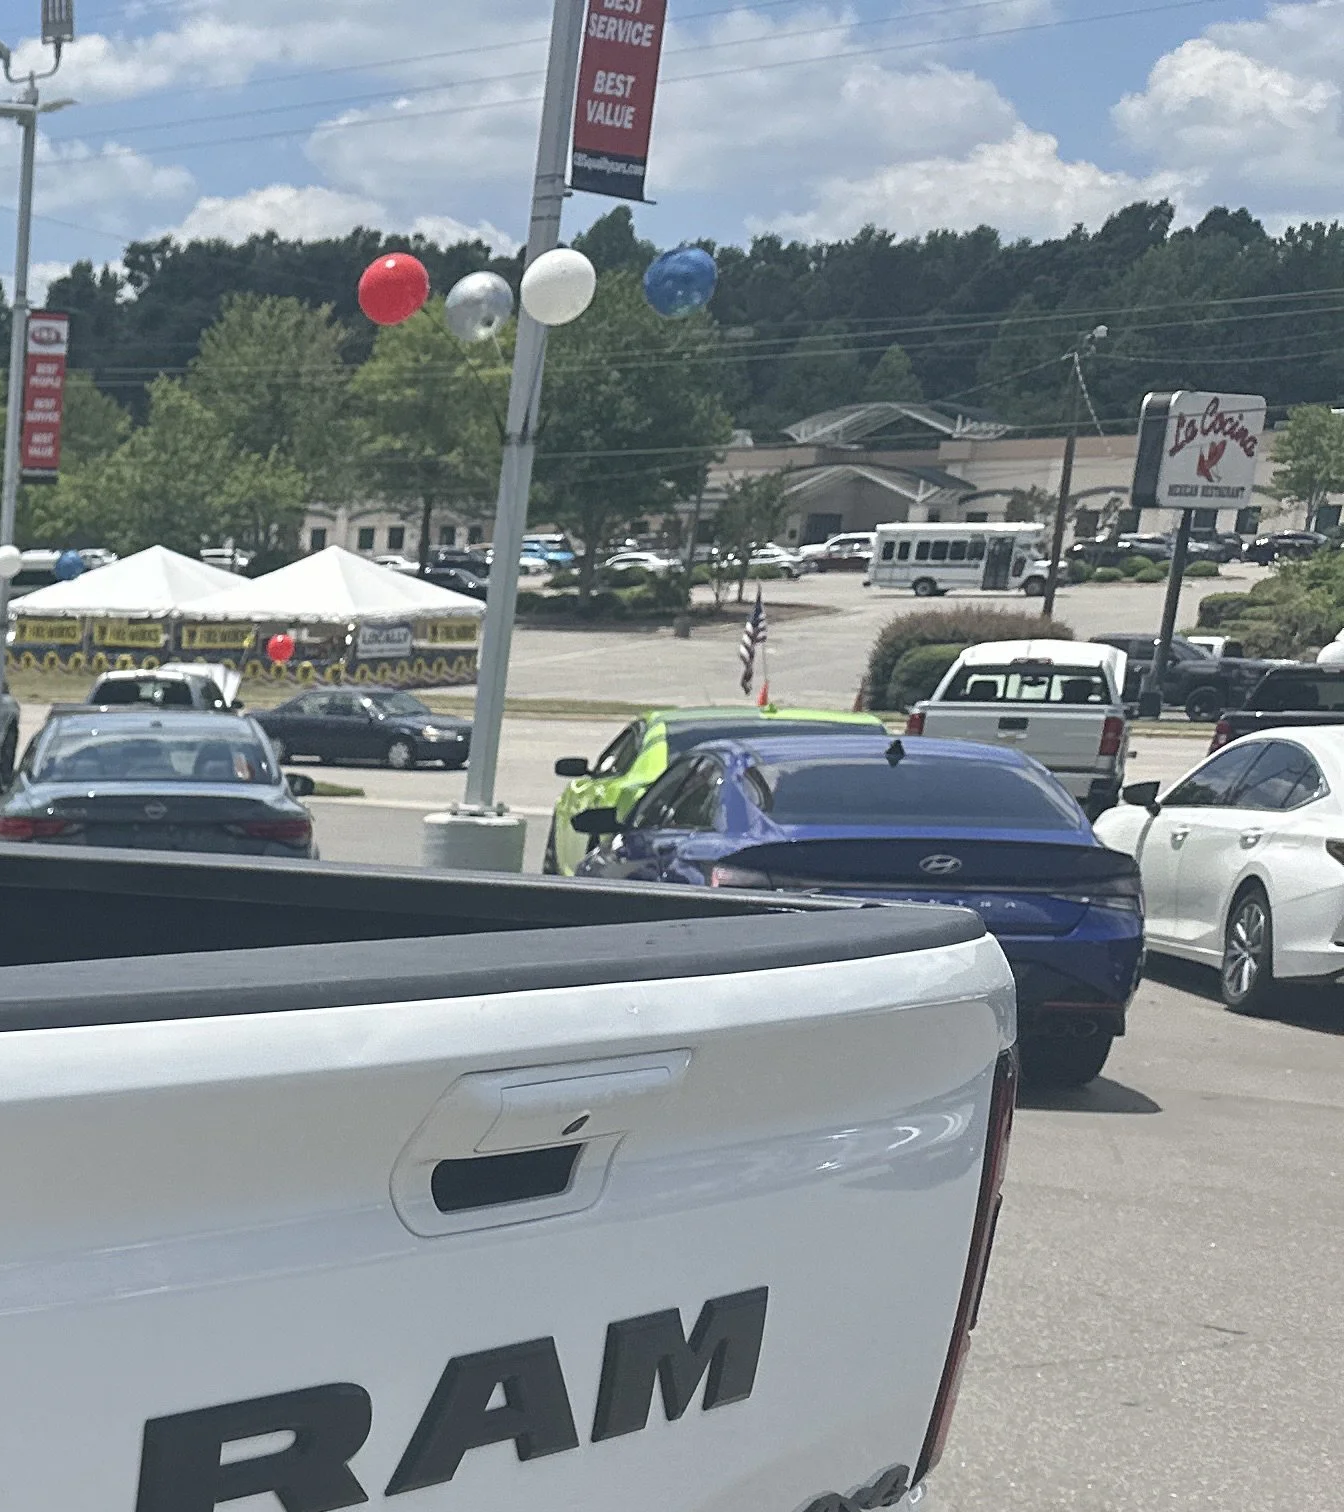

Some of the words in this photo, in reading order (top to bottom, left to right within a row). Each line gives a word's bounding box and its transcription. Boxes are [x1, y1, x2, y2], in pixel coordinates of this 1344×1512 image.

[588, 13, 655, 47] SERVICE
[593, 70, 636, 98] BEST
[587, 100, 636, 129] VALUE
[1169, 412, 1198, 457] La
[1200, 396, 1258, 457] Cocina
